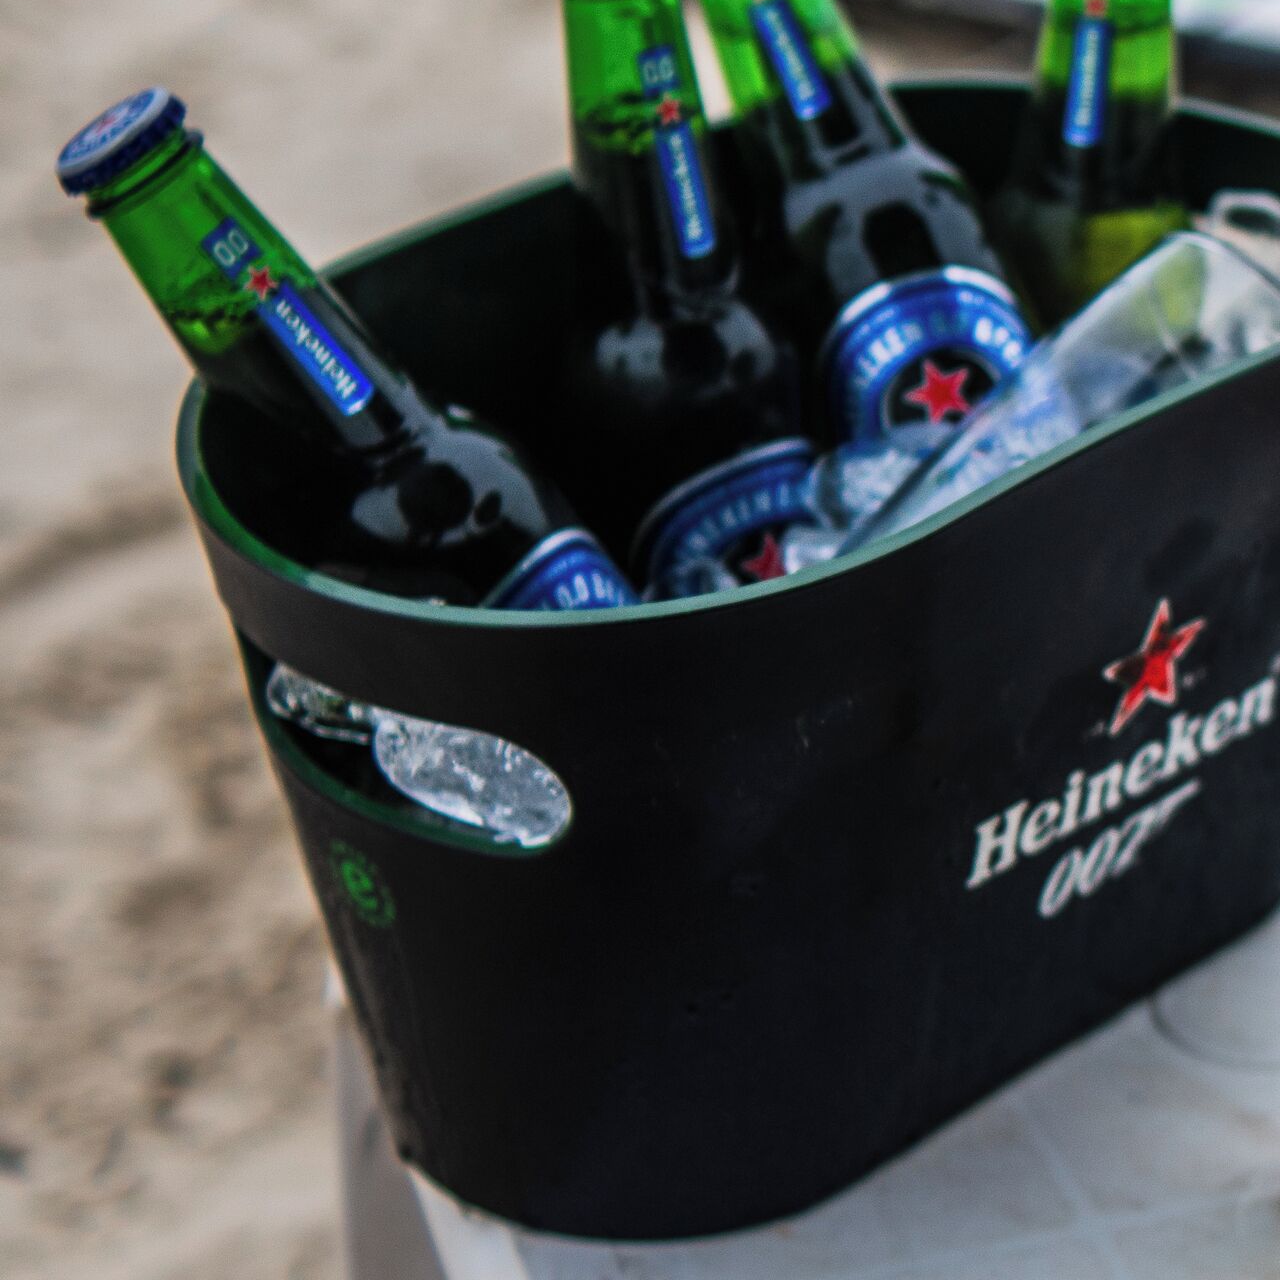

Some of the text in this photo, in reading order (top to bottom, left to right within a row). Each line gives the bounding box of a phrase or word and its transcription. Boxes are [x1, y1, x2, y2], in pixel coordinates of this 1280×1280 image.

[276, 299, 358, 400] Heineken
[965, 675, 1278, 891] Heineken
[1037, 776, 1203, 918] 007
